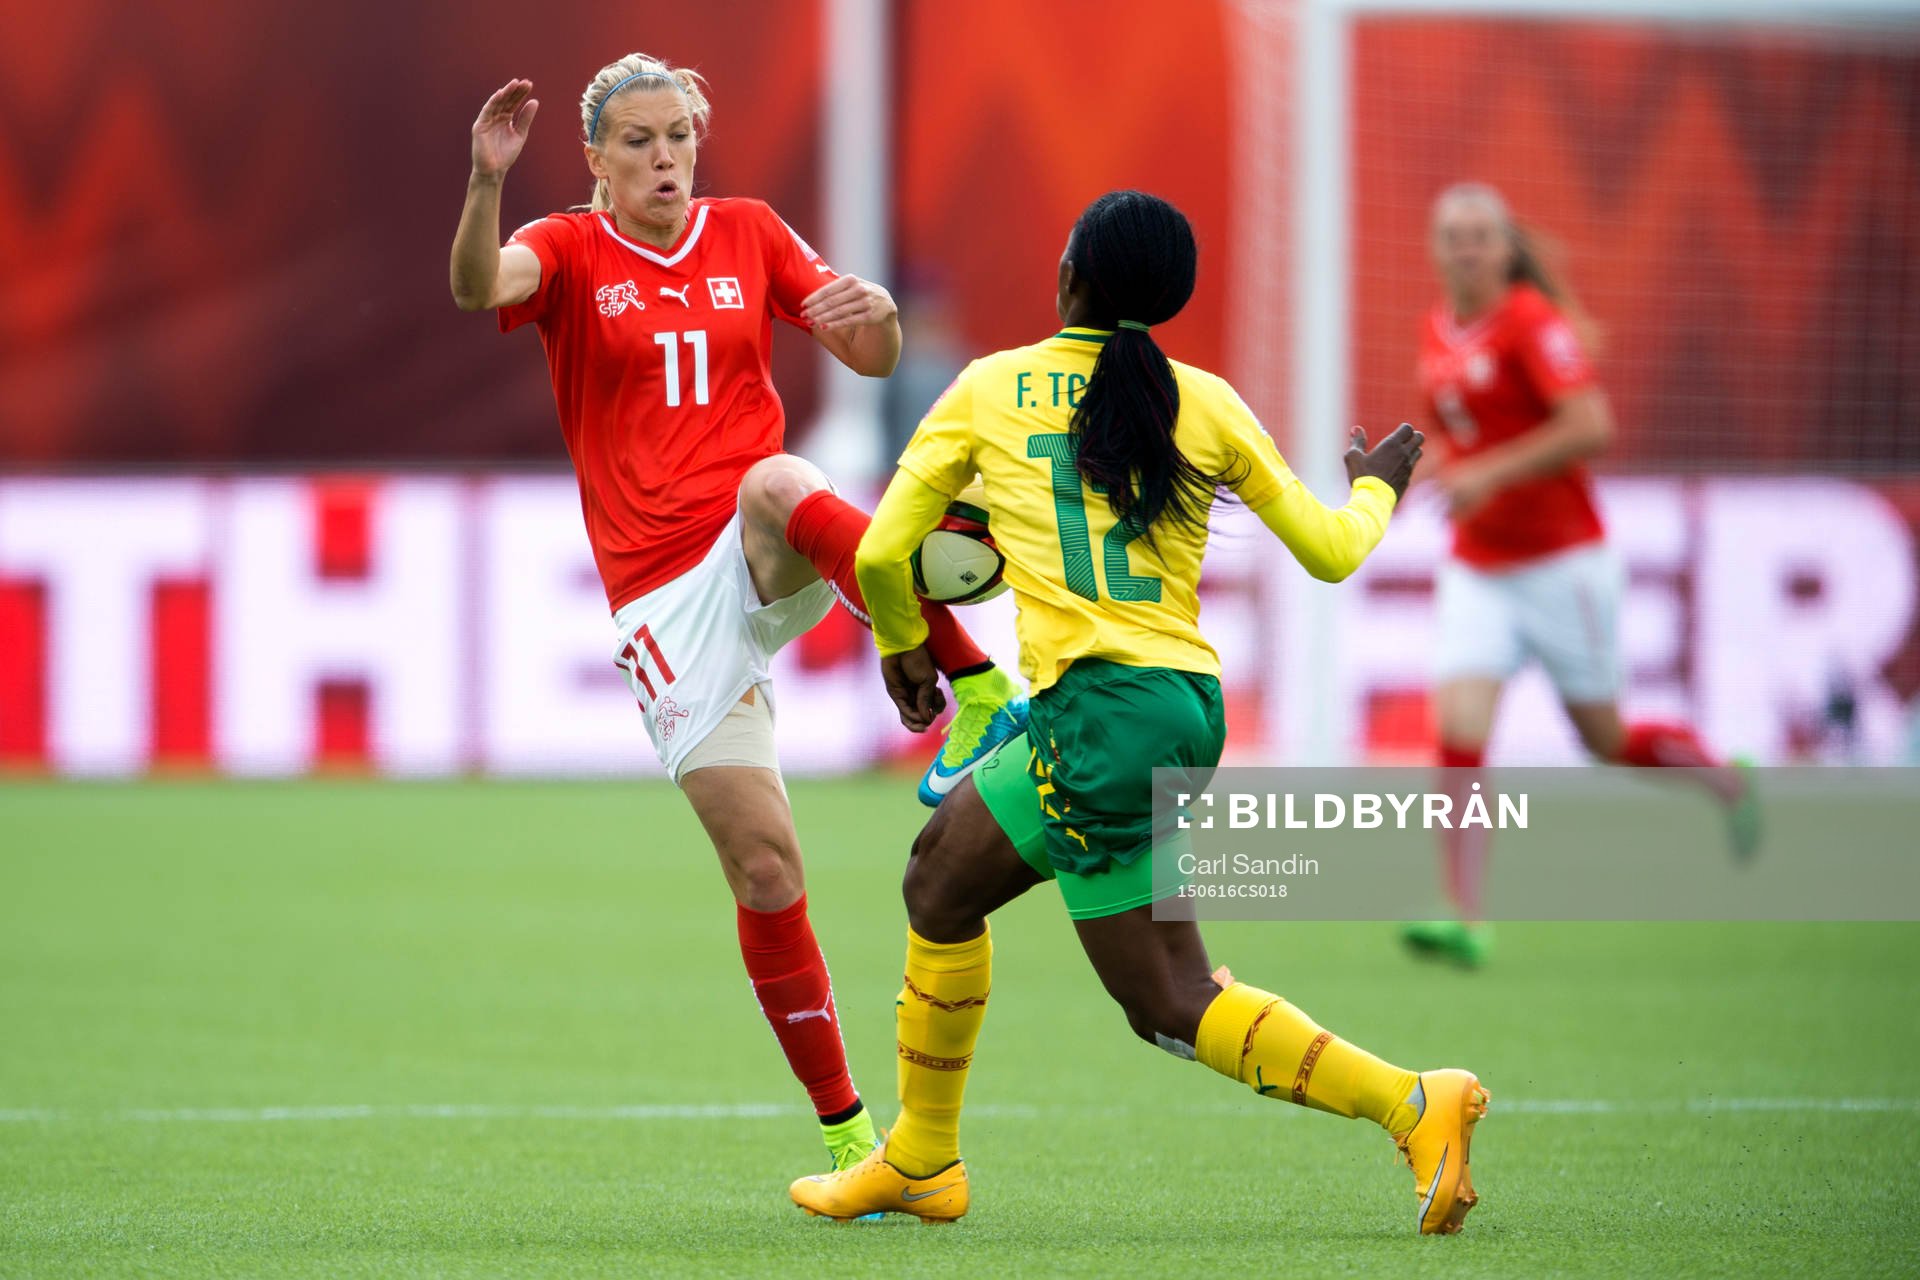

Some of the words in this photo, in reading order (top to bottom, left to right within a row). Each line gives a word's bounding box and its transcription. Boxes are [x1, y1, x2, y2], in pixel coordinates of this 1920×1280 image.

[654, 329, 709, 407] 11
[1017, 371, 1037, 408] F.
[1047, 372, 1087, 410] TC
[1027, 433, 1162, 603] 12
